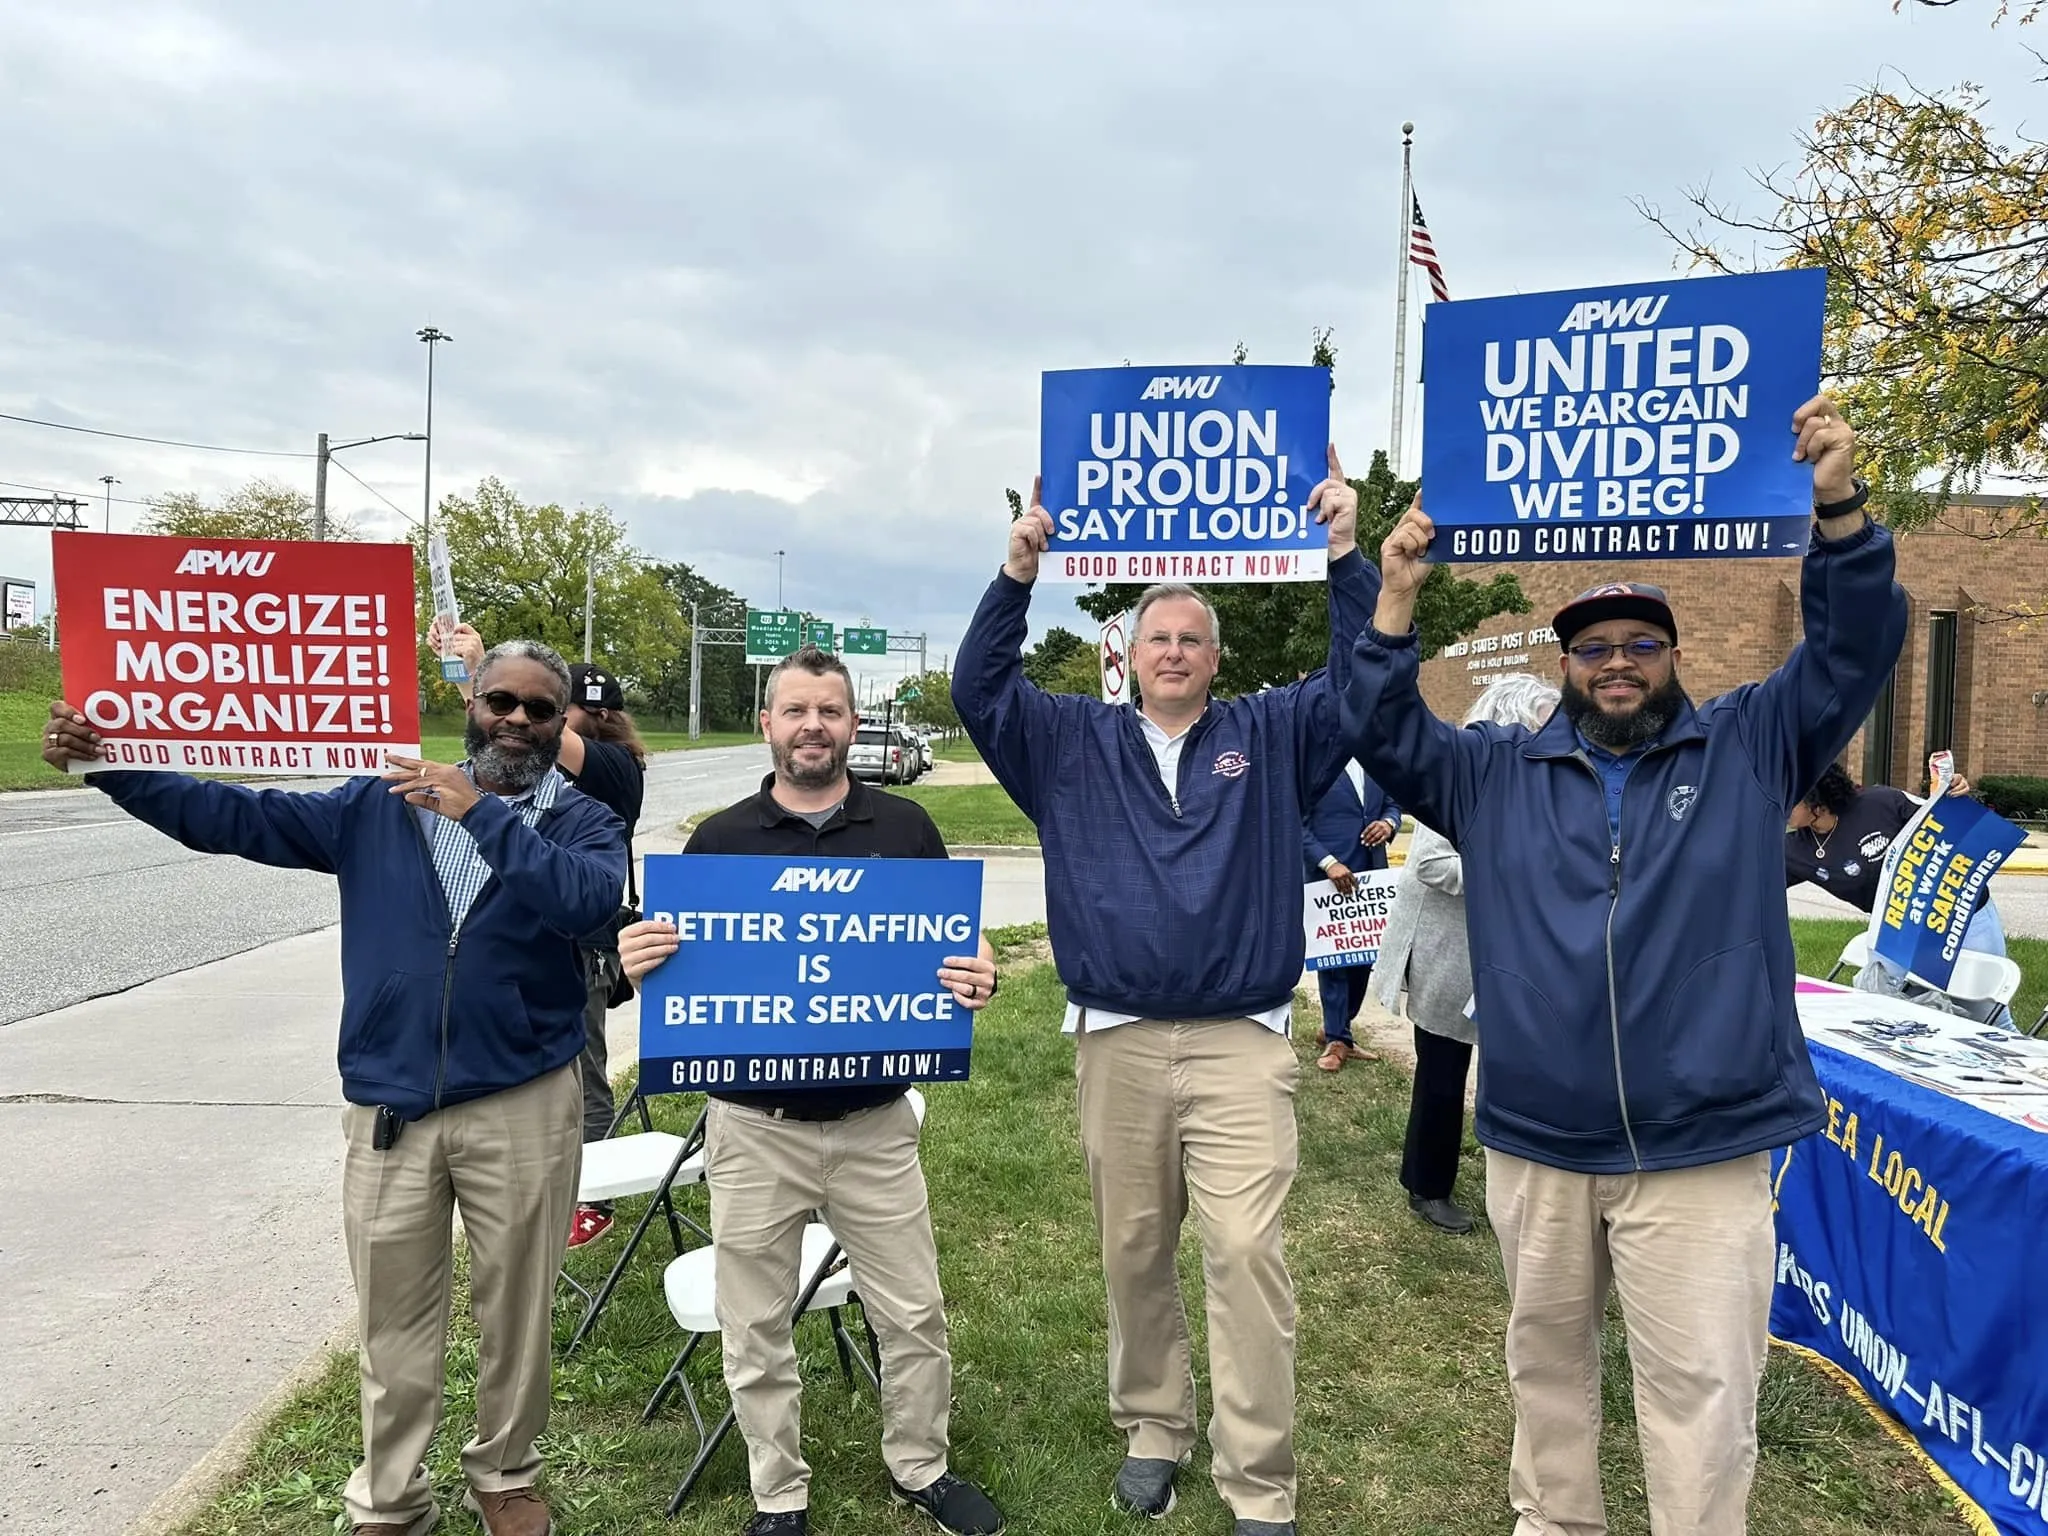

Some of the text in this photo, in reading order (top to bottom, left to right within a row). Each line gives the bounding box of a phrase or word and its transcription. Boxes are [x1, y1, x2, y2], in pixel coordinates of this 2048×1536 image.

[1559, 294, 1669, 332] APWU
[1484, 324, 1750, 398] UNITED
[1140, 376, 1223, 400] APWU
[1479, 384, 1748, 432] WE BARGAIN
[1090, 410, 1277, 459] UNION
[1486, 422, 1740, 482] DIVIDED
[1078, 456, 1288, 506] PROUD!
[1510, 476, 1705, 520] WE BEG!
[1057, 506, 1308, 542] SAY IT LOUD!
[1453, 523, 1770, 555] GOOD CONTRACT NOW!
[175, 549, 276, 577] APWU
[1066, 554, 1299, 577] GOOD CONTRACT NOW!
[103, 587, 389, 636] ENERGIZE!
[1472, 636, 1498, 655] STATES
[1501, 632, 1524, 649] POST
[1504, 654, 1529, 666] BUILDING
[115, 640, 391, 686] MOBILIZE!
[84, 691, 394, 734] ORGANIZE!
[104, 743, 171, 764] GOOD
[183, 745, 313, 768] CONTRACT
[771, 867, 864, 892] APWU
[1884, 814, 1944, 930] RESPECT
[1909, 840, 1954, 925] at work
[1926, 854, 1975, 935] SAFER
[1942, 849, 2003, 962] conditions
[796, 913, 971, 944] STAFFING
[1316, 918, 1387, 939] ARE HUM
[1330, 902, 1388, 922] RIGHTS
[1334, 934, 1382, 951] RIGHT
[798, 954, 831, 984] IS
[1317, 952, 1376, 968] GOOD CONTR
[664, 993, 953, 1026] BETTER SERVICE
[672, 1053, 942, 1085] GOOD CONTRACT NOW!
[1867, 1133, 1951, 1254] LOCAL
